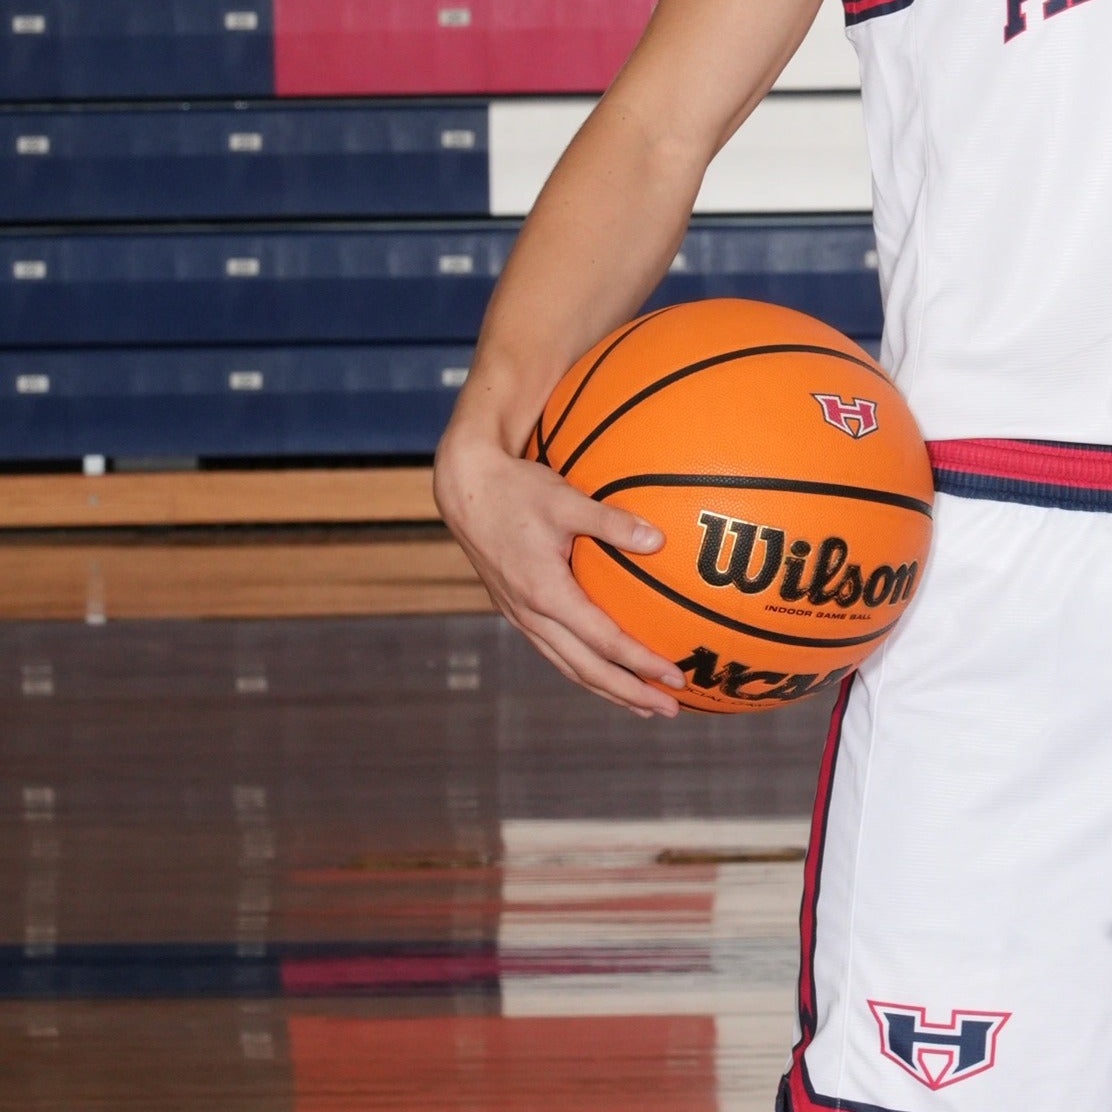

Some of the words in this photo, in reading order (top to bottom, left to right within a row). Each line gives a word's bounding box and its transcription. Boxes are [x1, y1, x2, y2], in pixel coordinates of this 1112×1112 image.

[696, 509, 918, 608] Wilson
[764, 604, 813, 617] INDOOR
[816, 611, 846, 620] GAME
[849, 612, 872, 620] BALL
